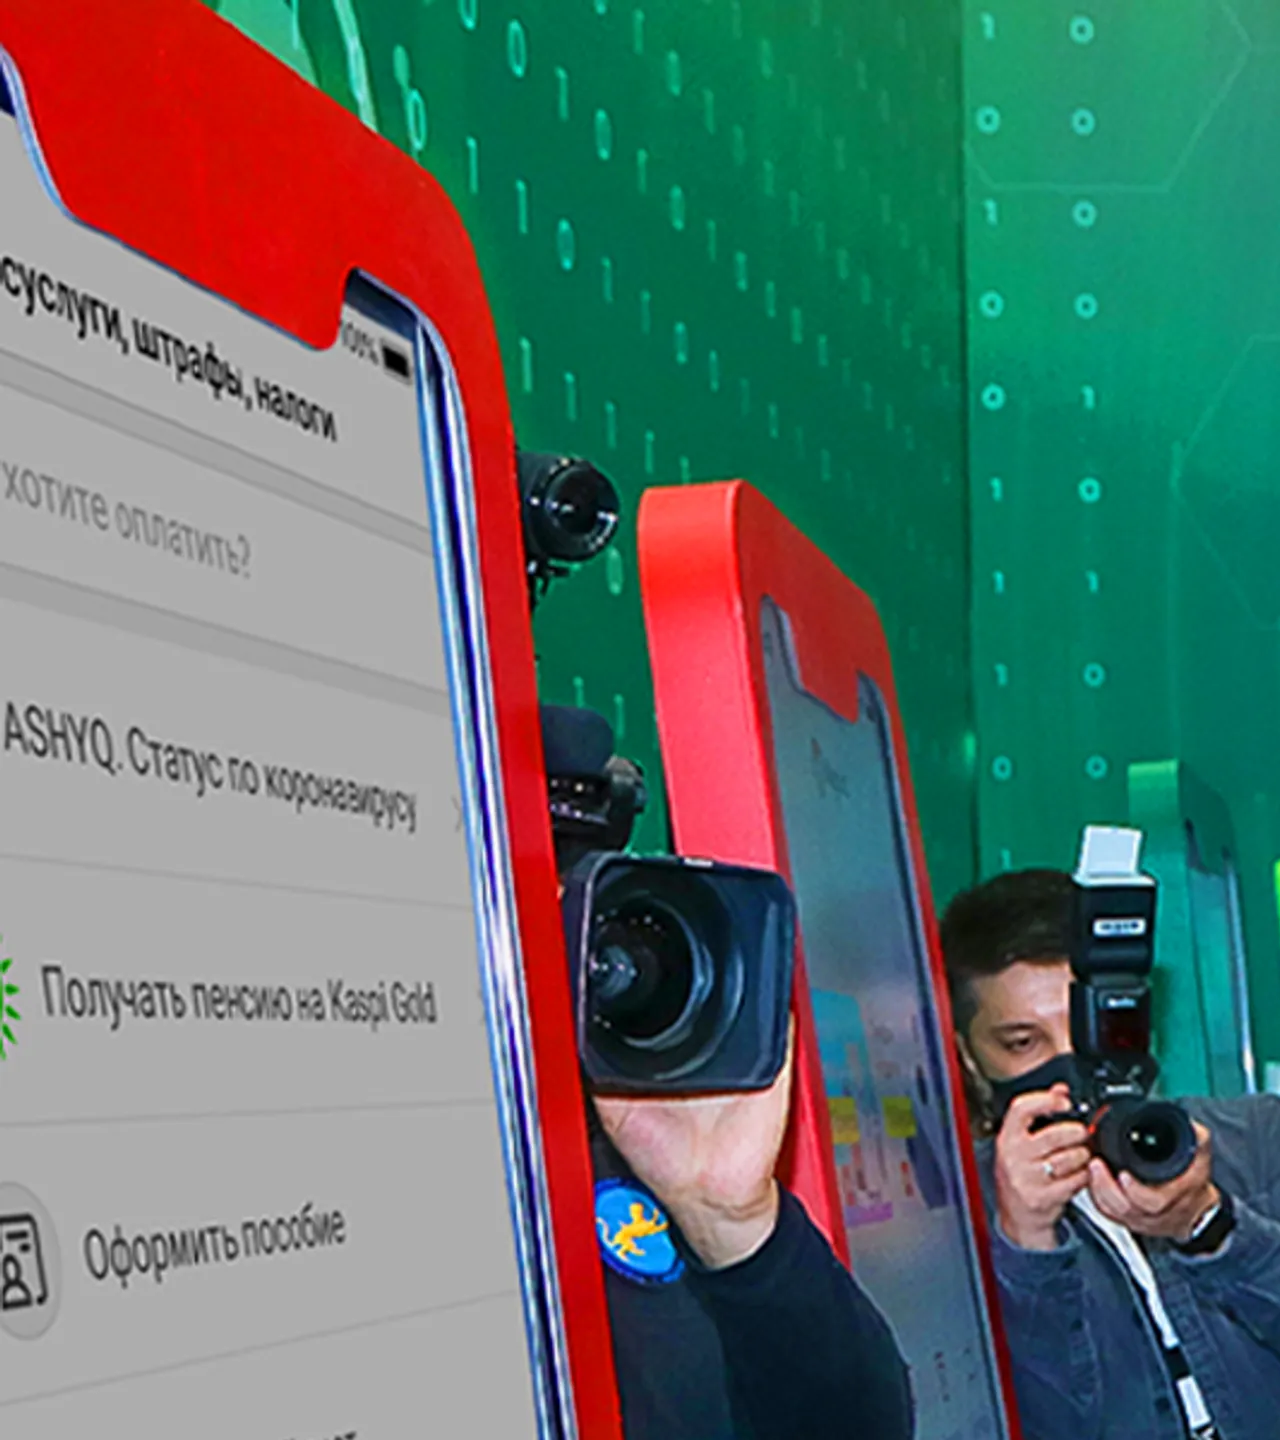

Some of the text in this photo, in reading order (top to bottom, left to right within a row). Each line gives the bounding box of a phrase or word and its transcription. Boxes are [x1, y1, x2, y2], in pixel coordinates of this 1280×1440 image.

[0, 256, 337, 442] суслуги, штрафы, налоги
[0, 460, 251, 580] хотите оплатить?
[3, 700, 417, 834] ASHYQ. Статус по коронавирусу
[41, 963, 438, 1034] Получать пенсию на Kaspi Gold
[82, 1201, 347, 1291] Оформить пособие
